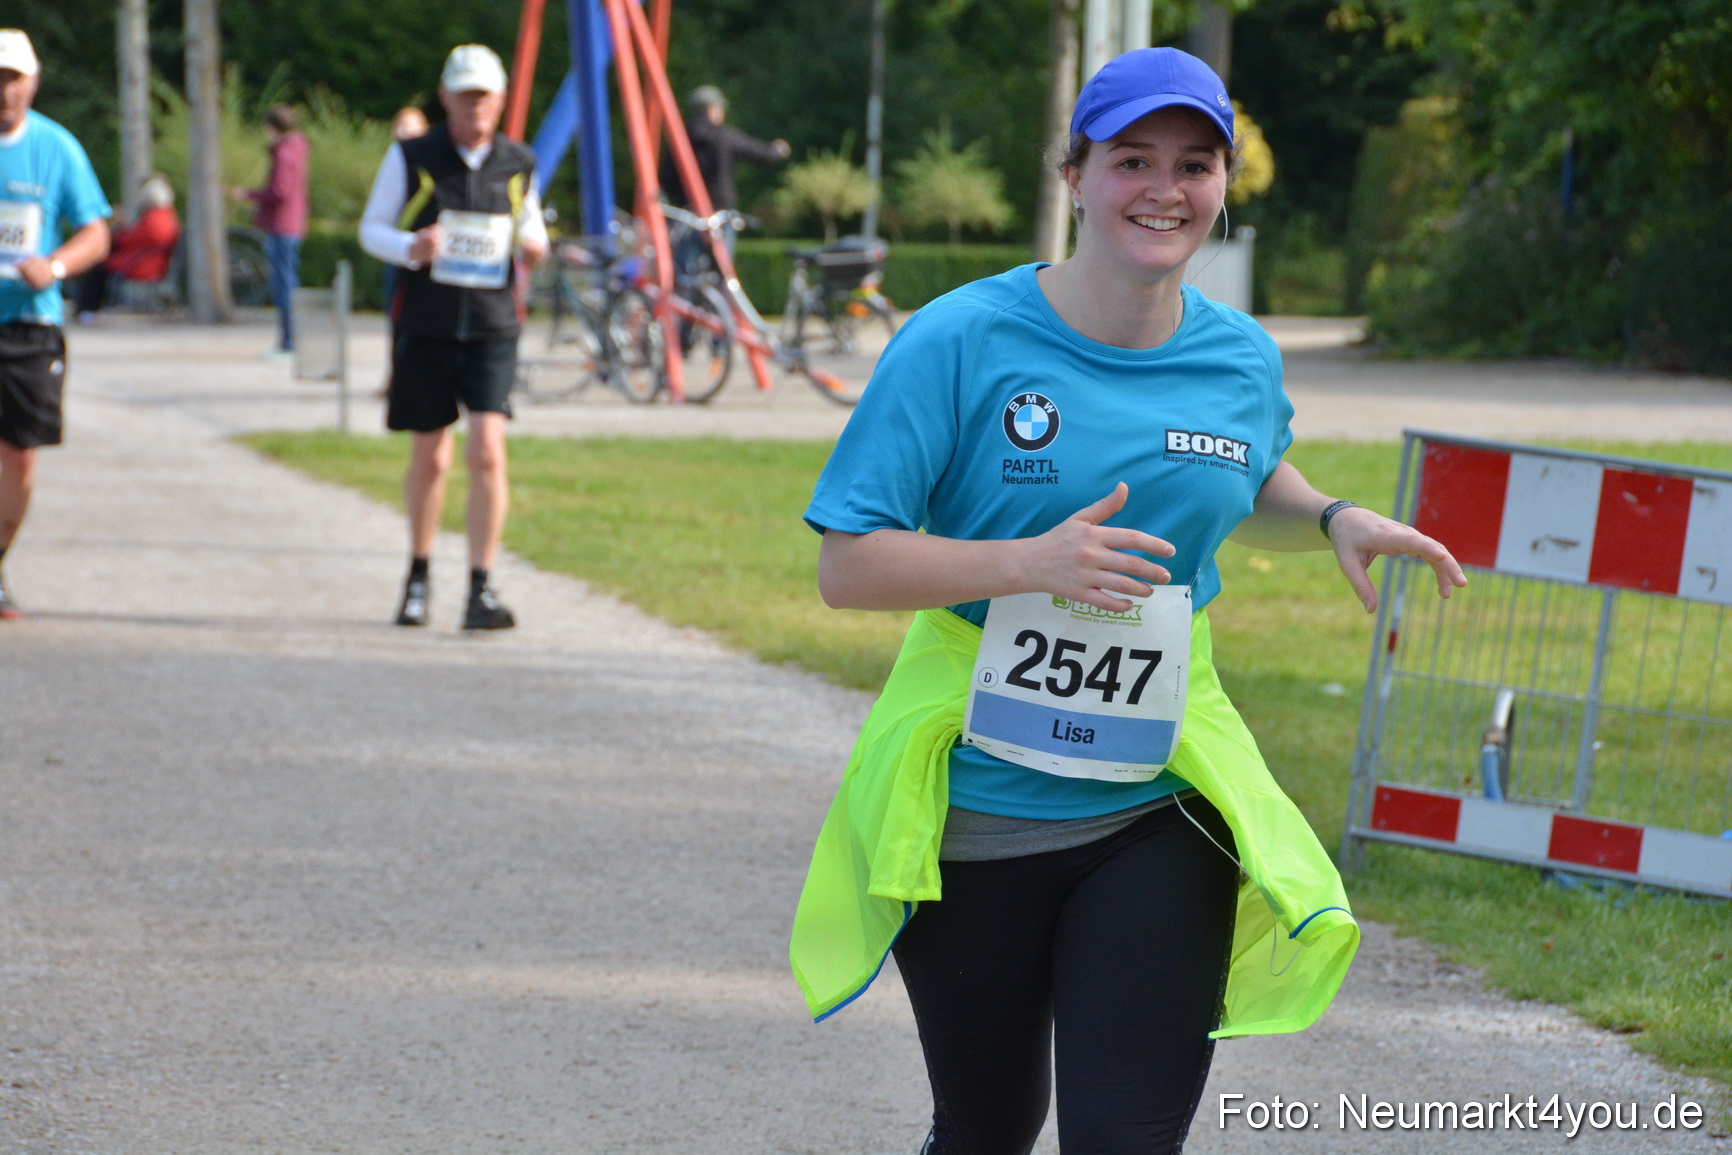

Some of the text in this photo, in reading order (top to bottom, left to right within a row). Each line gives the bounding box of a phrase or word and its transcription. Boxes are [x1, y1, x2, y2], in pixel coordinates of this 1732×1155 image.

[1008, 394, 1056, 414] BMW
[1165, 429, 1251, 467] BOCK
[1002, 459, 1059, 473] PARTL
[1163, 454, 1196, 464] inspired
[1198, 457, 1208, 466] by
[1210, 460, 1229, 470] smart
[1002, 473, 1059, 485] Neumarkt
[1070, 613, 1092, 622] inspired
[1005, 629, 1163, 705] 2547
[1051, 719, 1095, 744] Lisa
